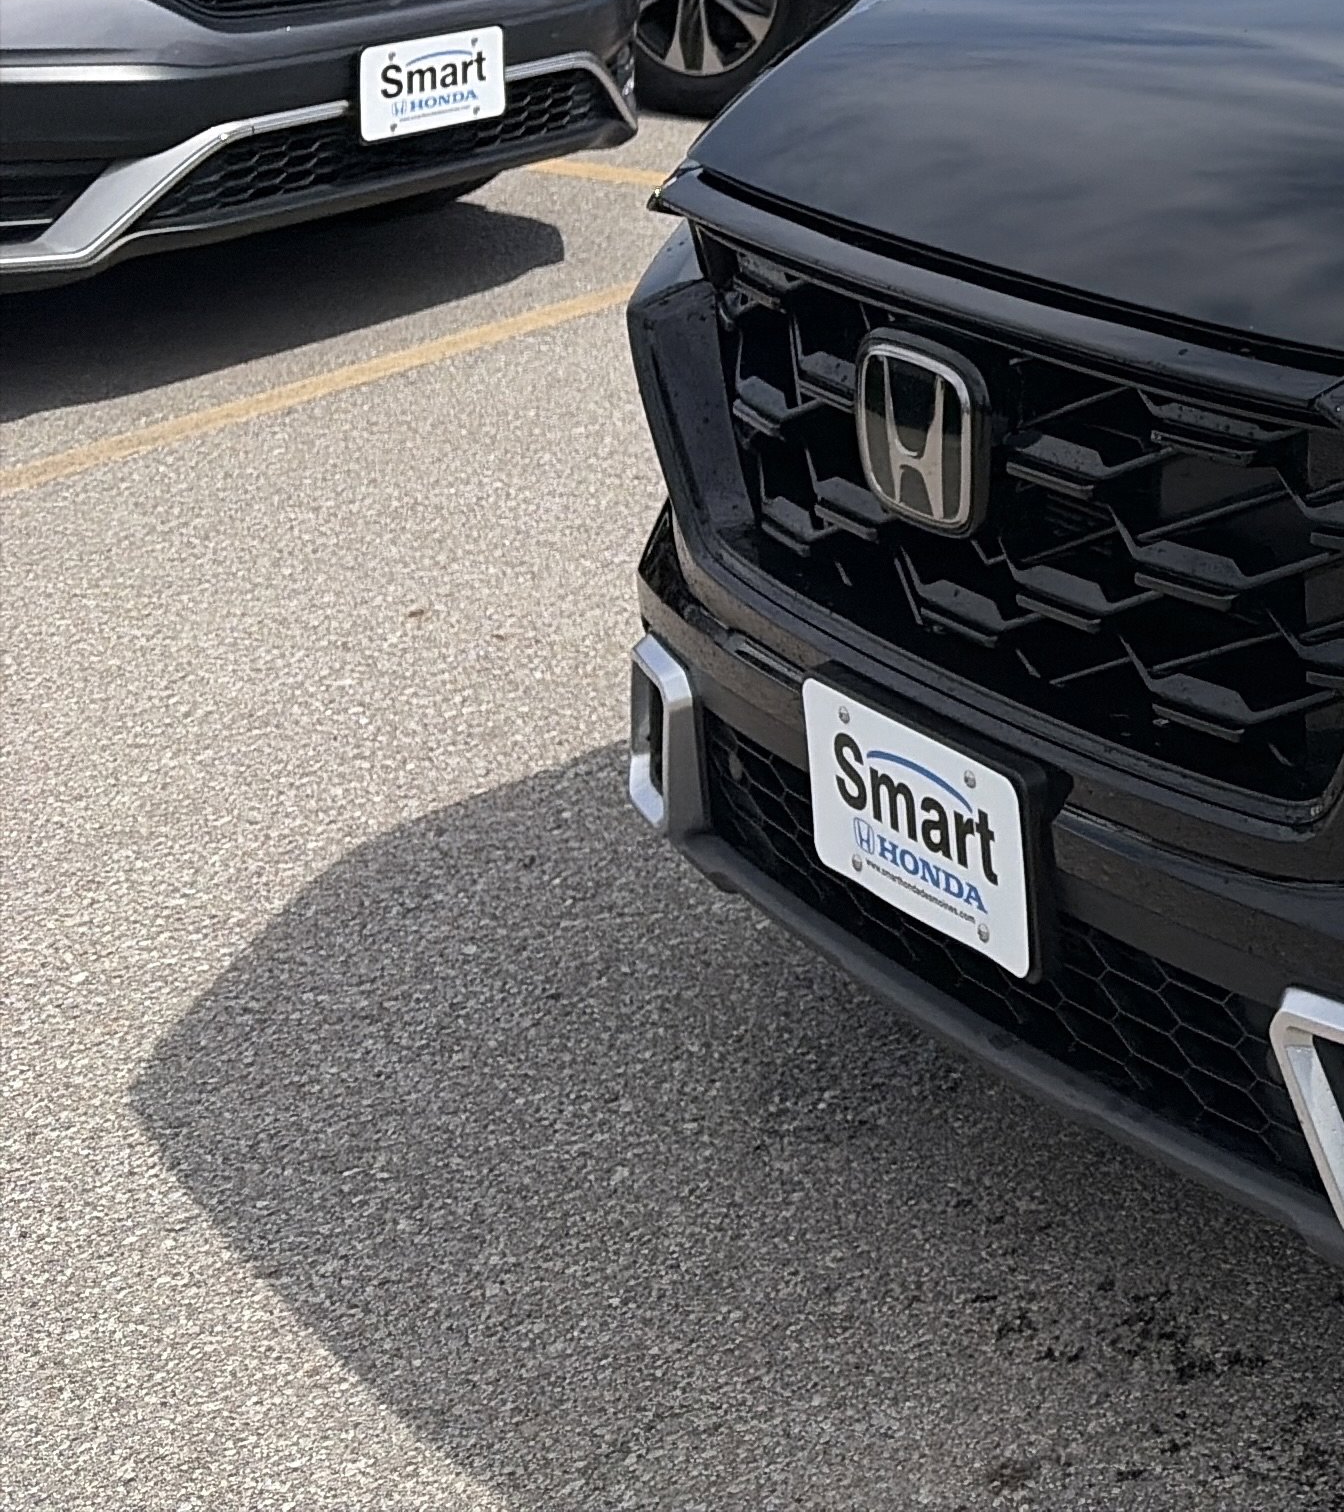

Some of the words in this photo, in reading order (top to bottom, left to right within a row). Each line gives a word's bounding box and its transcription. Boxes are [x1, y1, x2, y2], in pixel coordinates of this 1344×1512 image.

[381, 50, 487, 99] Smart
[410, 89, 479, 113] HONDA
[834, 733, 999, 886] Smart
[877, 834, 988, 915] HONDA
